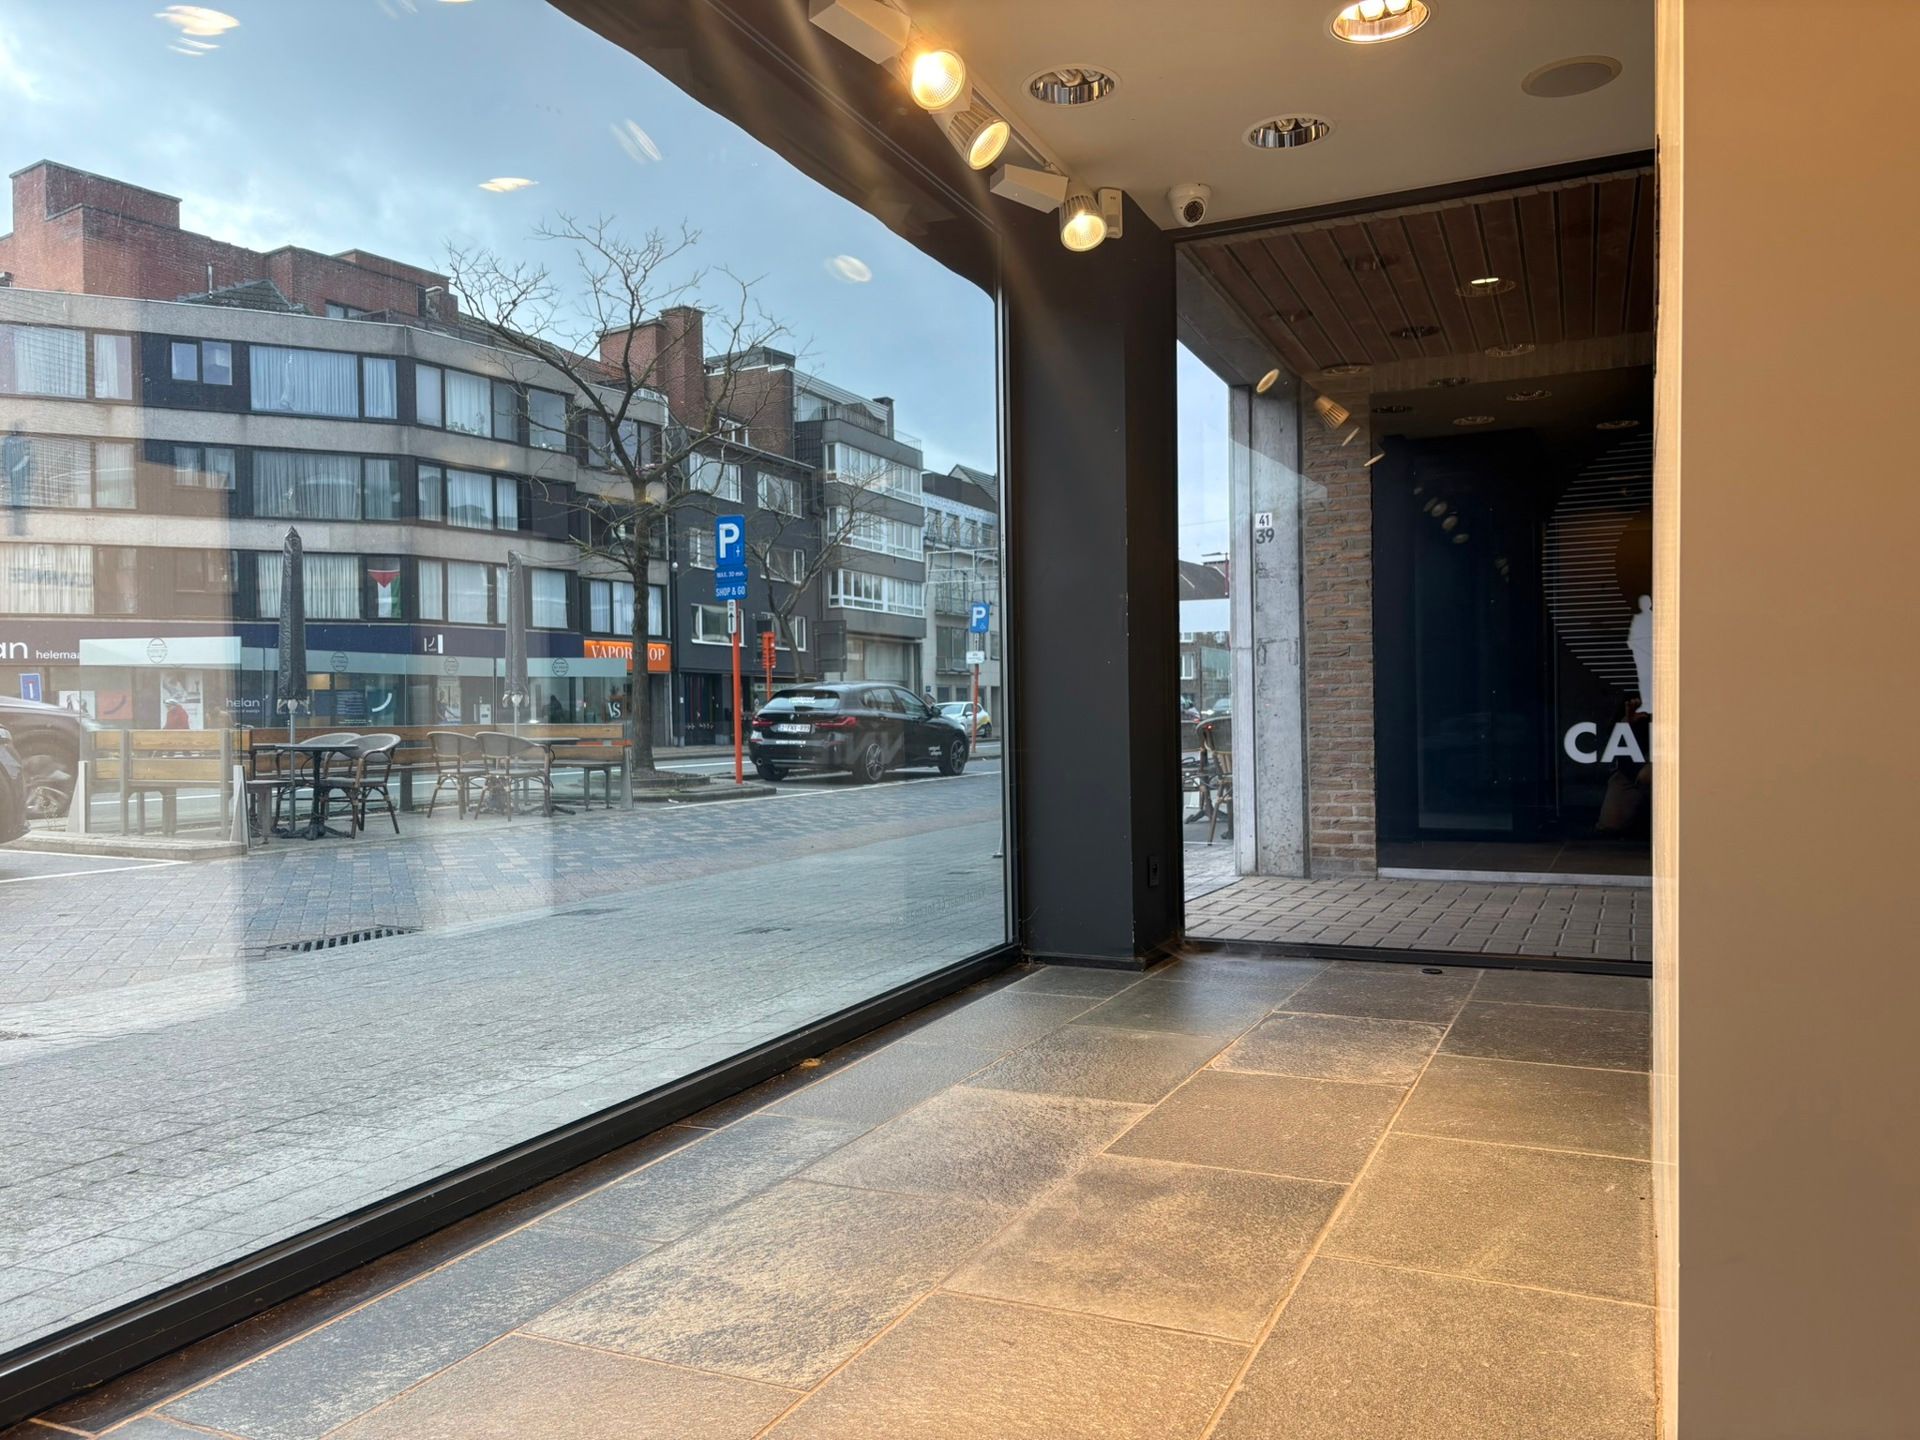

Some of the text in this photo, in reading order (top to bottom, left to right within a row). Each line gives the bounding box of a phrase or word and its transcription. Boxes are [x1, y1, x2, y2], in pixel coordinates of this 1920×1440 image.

[1259, 514, 1270, 526] 41
[719, 523, 740, 558] P
[1256, 528, 1275, 544] 39
[716, 586, 746, 597] SHOP & GO
[972, 606, 986, 627] P
[225, 697, 260, 707] helan
[608, 702, 621, 718] VS
[1564, 722, 1653, 764] CA
